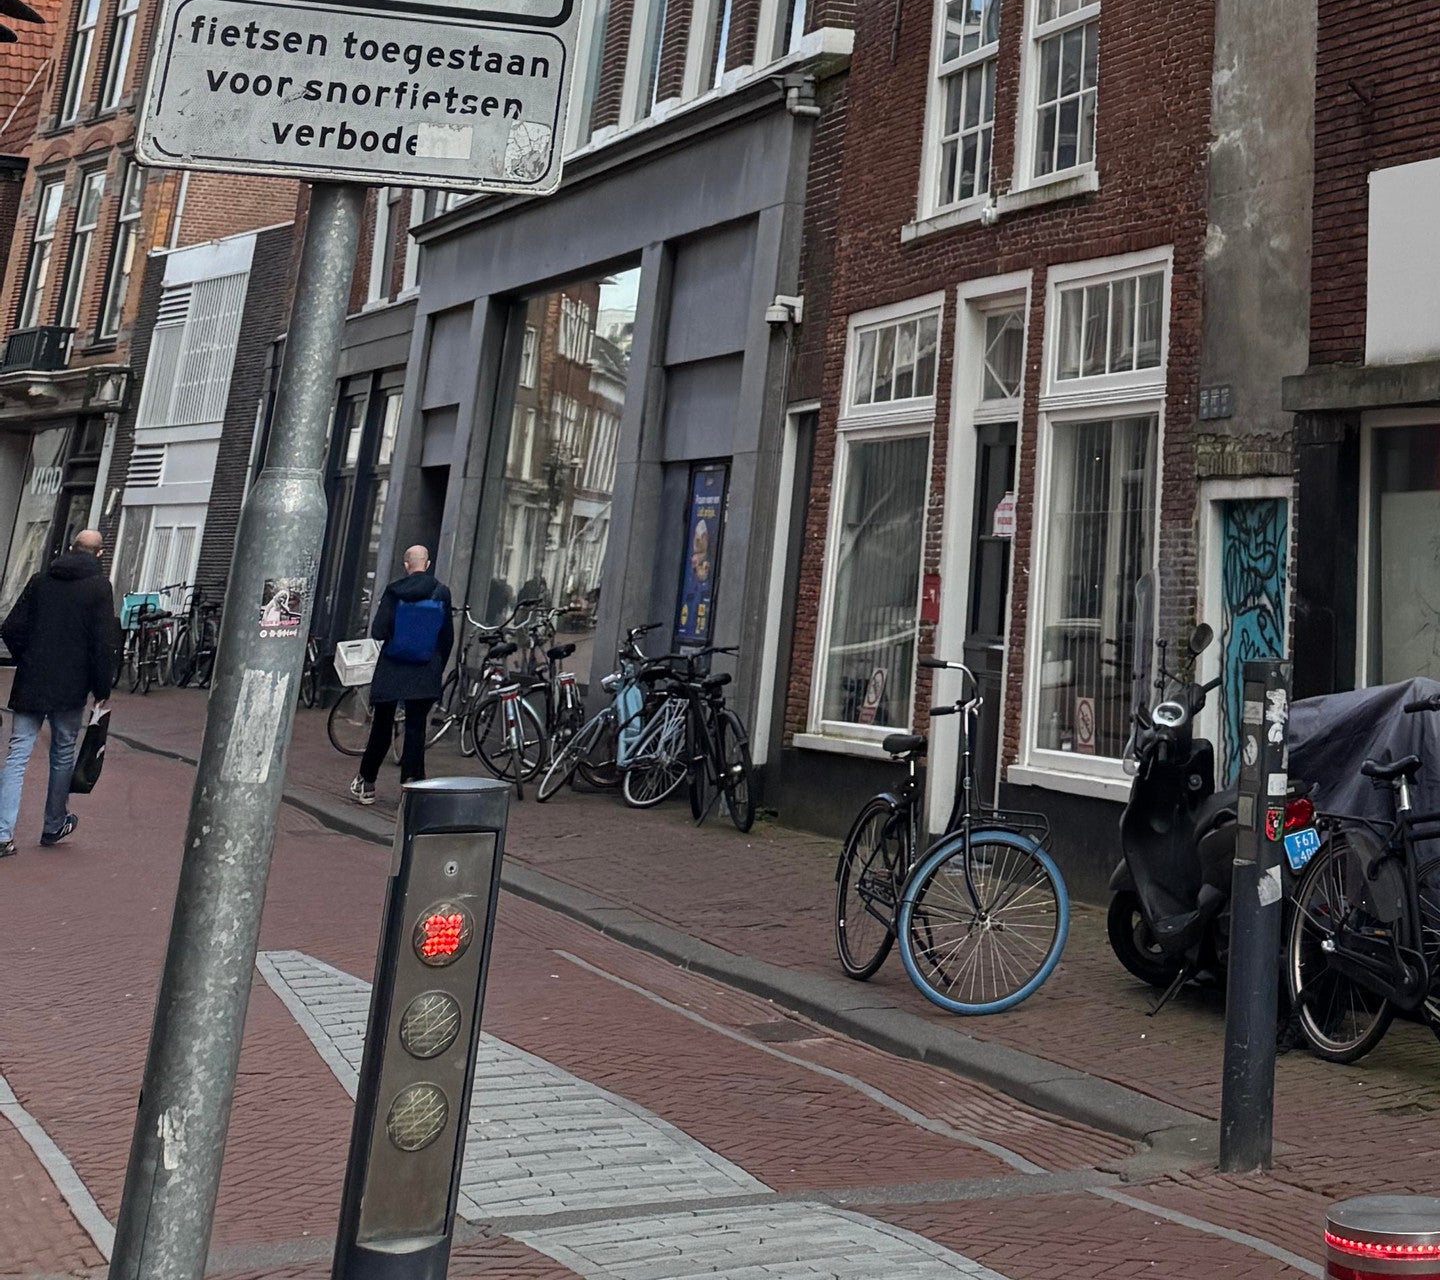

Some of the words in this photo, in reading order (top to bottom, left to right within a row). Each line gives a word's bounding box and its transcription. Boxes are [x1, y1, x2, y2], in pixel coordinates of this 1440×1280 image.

[190, 15, 328, 57] fietsen
[343, 31, 550, 79] toegestaan
[206, 69, 293, 98] voor
[303, 79, 523, 120] snorfietsen
[272, 121, 419, 157] verbode
[1295, 831, 1314, 848] F67
